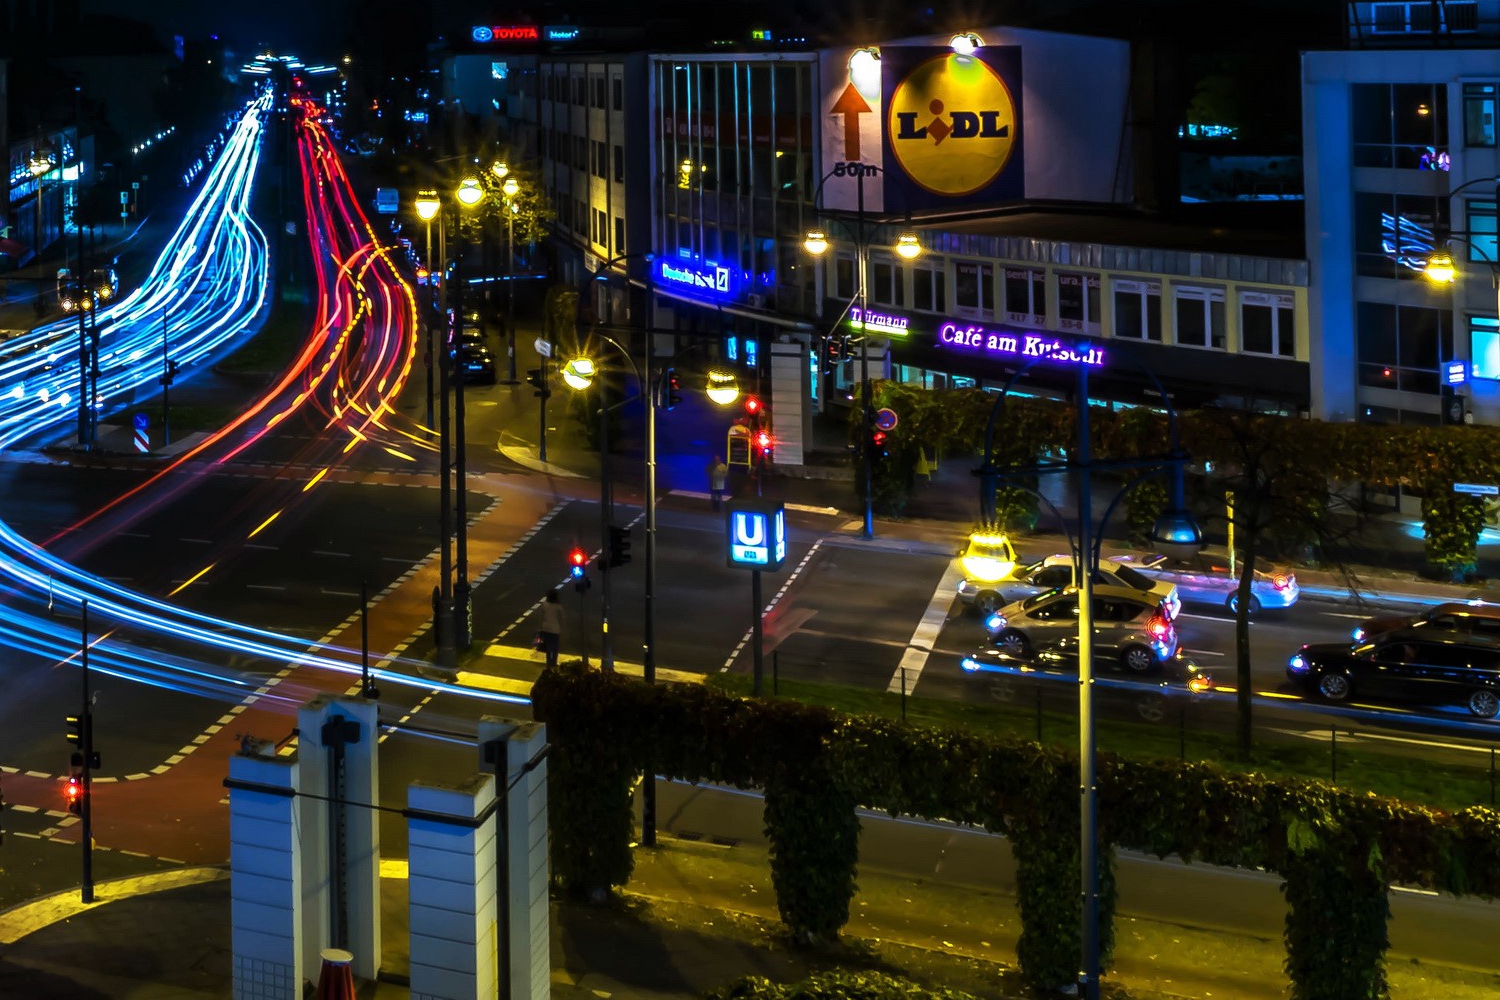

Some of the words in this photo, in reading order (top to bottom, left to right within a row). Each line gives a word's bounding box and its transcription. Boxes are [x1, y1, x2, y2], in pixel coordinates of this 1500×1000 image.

[493, 28, 538, 39] TOYOTA
[897, 99, 1009, 146] LIDL
[942, 324, 983, 347] Café
[987, 335, 1017, 352] am
[736, 513, 764, 546] U
